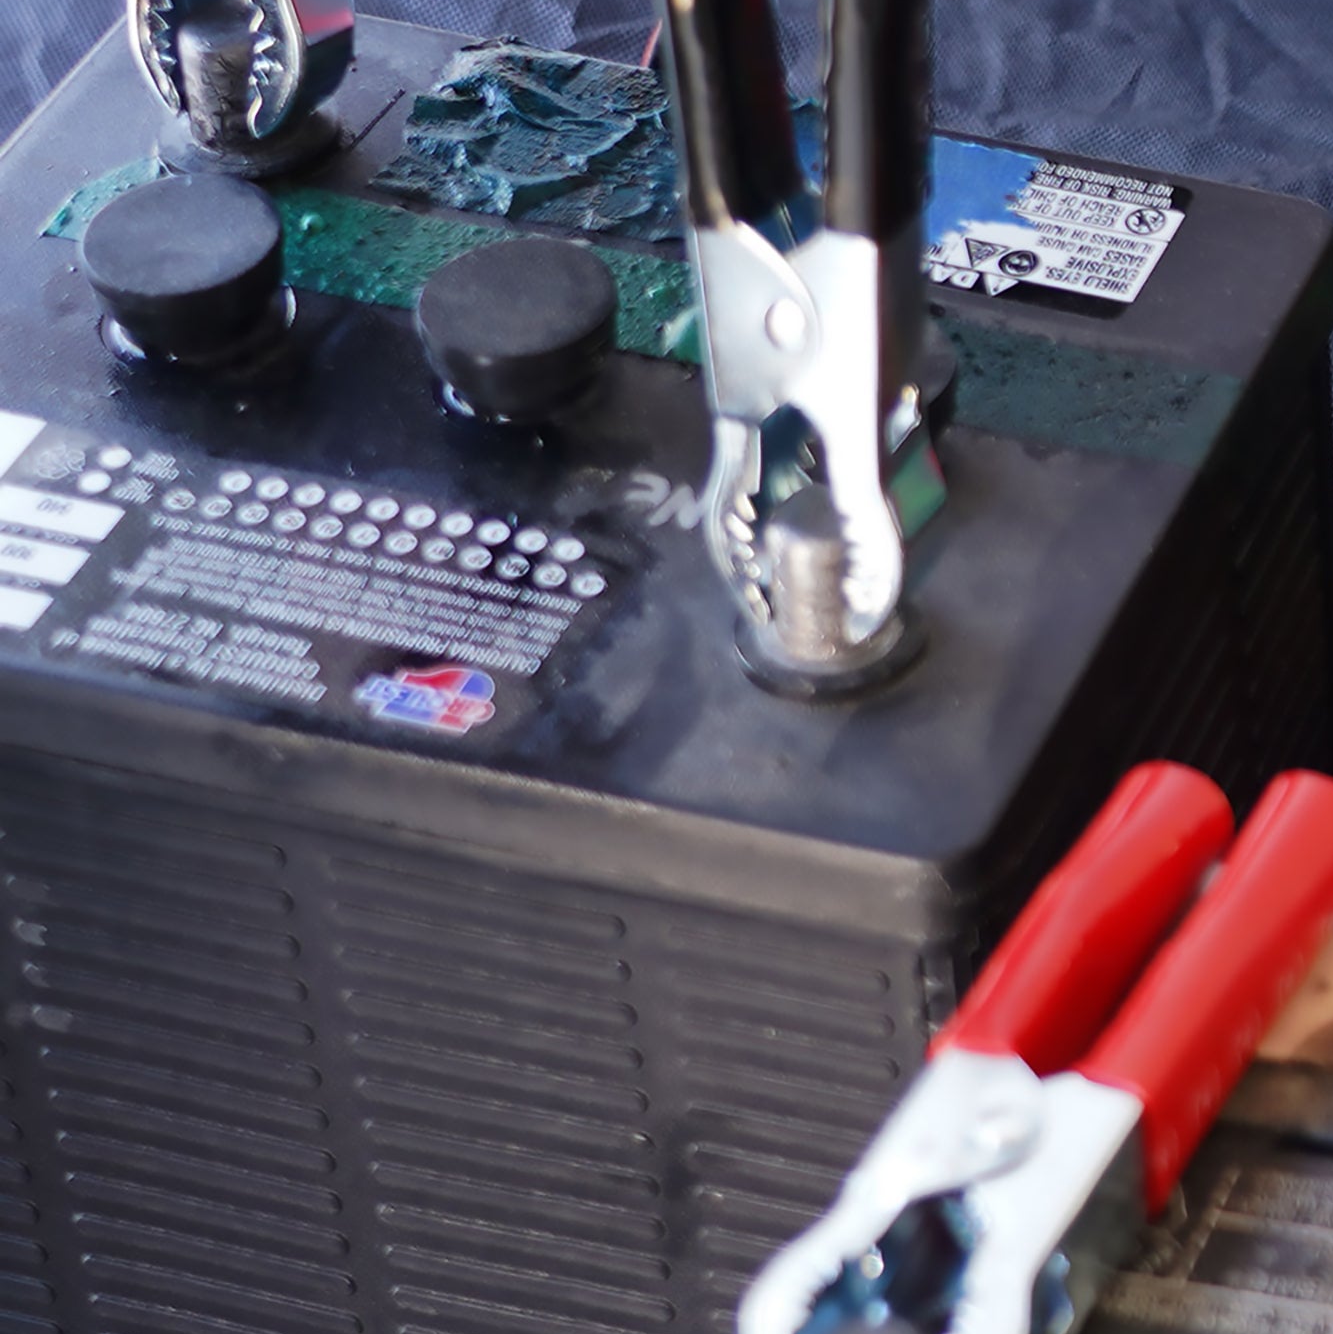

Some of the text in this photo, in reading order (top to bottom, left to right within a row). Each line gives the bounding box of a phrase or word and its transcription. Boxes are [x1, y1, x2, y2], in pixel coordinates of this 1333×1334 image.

[1058, 164, 1174, 197] NOT RECOMMENDED
[1063, 179, 1081, 192] OF
[1084, 182, 1110, 199] RISK
[1112, 189, 1172, 209] WARNING:
[1060, 195, 1078, 207] OF
[1054, 209, 1081, 222] OUT
[1036, 236, 1074, 255] CAUSE
[1065, 256, 1140, 280] EXPLOSIVE
[1084, 275, 1133, 294] SHIELD
[191, 522, 231, 540] DATE
[227, 529, 277, 547] SHOW
[274, 536, 295, 552] TO
[333, 547, 374, 567] YEAR
[373, 554, 408, 574] AND
[407, 564, 462, 586] MONTH
[461, 576, 521, 600] PROPER
[520, 588, 582, 615] REMOVE
